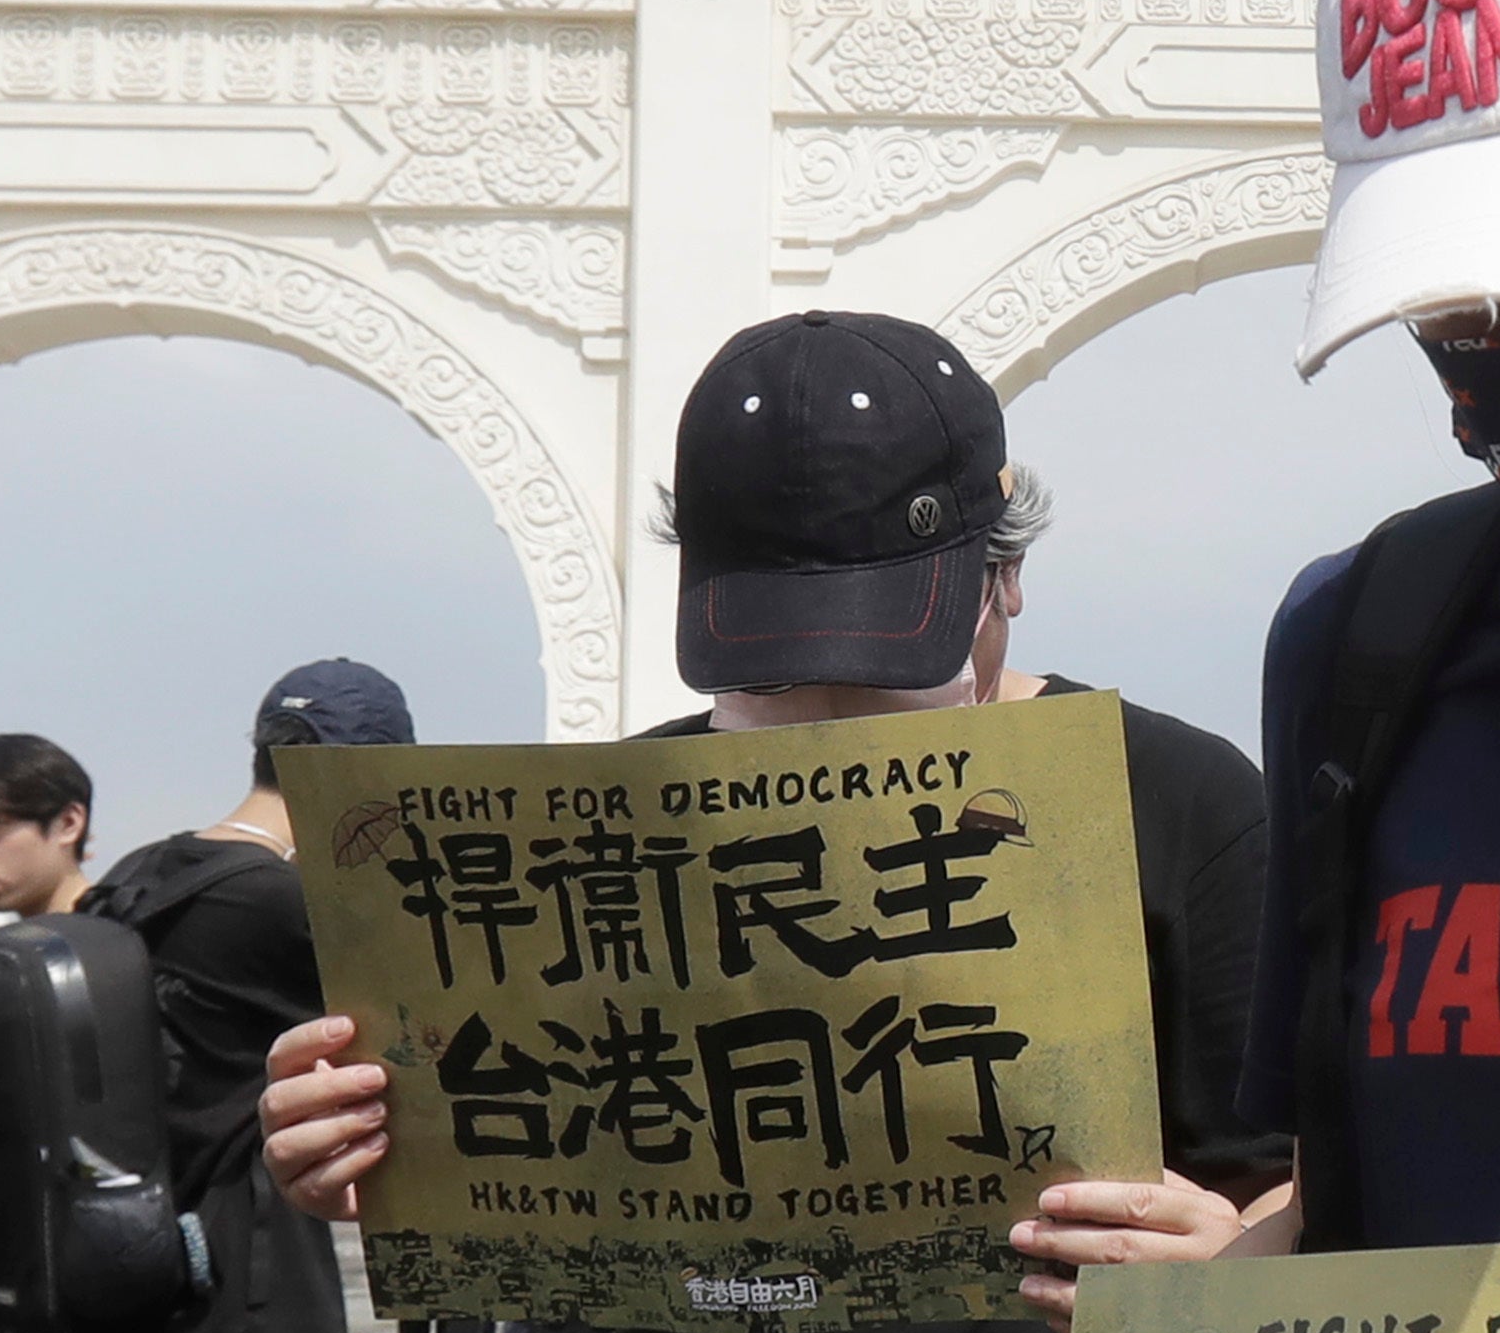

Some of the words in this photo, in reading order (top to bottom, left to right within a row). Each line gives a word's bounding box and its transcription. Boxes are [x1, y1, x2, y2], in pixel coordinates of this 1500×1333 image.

[398, 784, 518, 822] FIGHT
[545, 777, 631, 820] FOR
[660, 749, 971, 816] DEMOCRACY
[387, 805, 1016, 988] 捍衛民主
[436, 997, 1029, 1187] 台港同行
[617, 1180, 752, 1224] STAND
[778, 1172, 1008, 1218] TOGETHER
[686, 1276, 818, 1304] 香港自由六月
